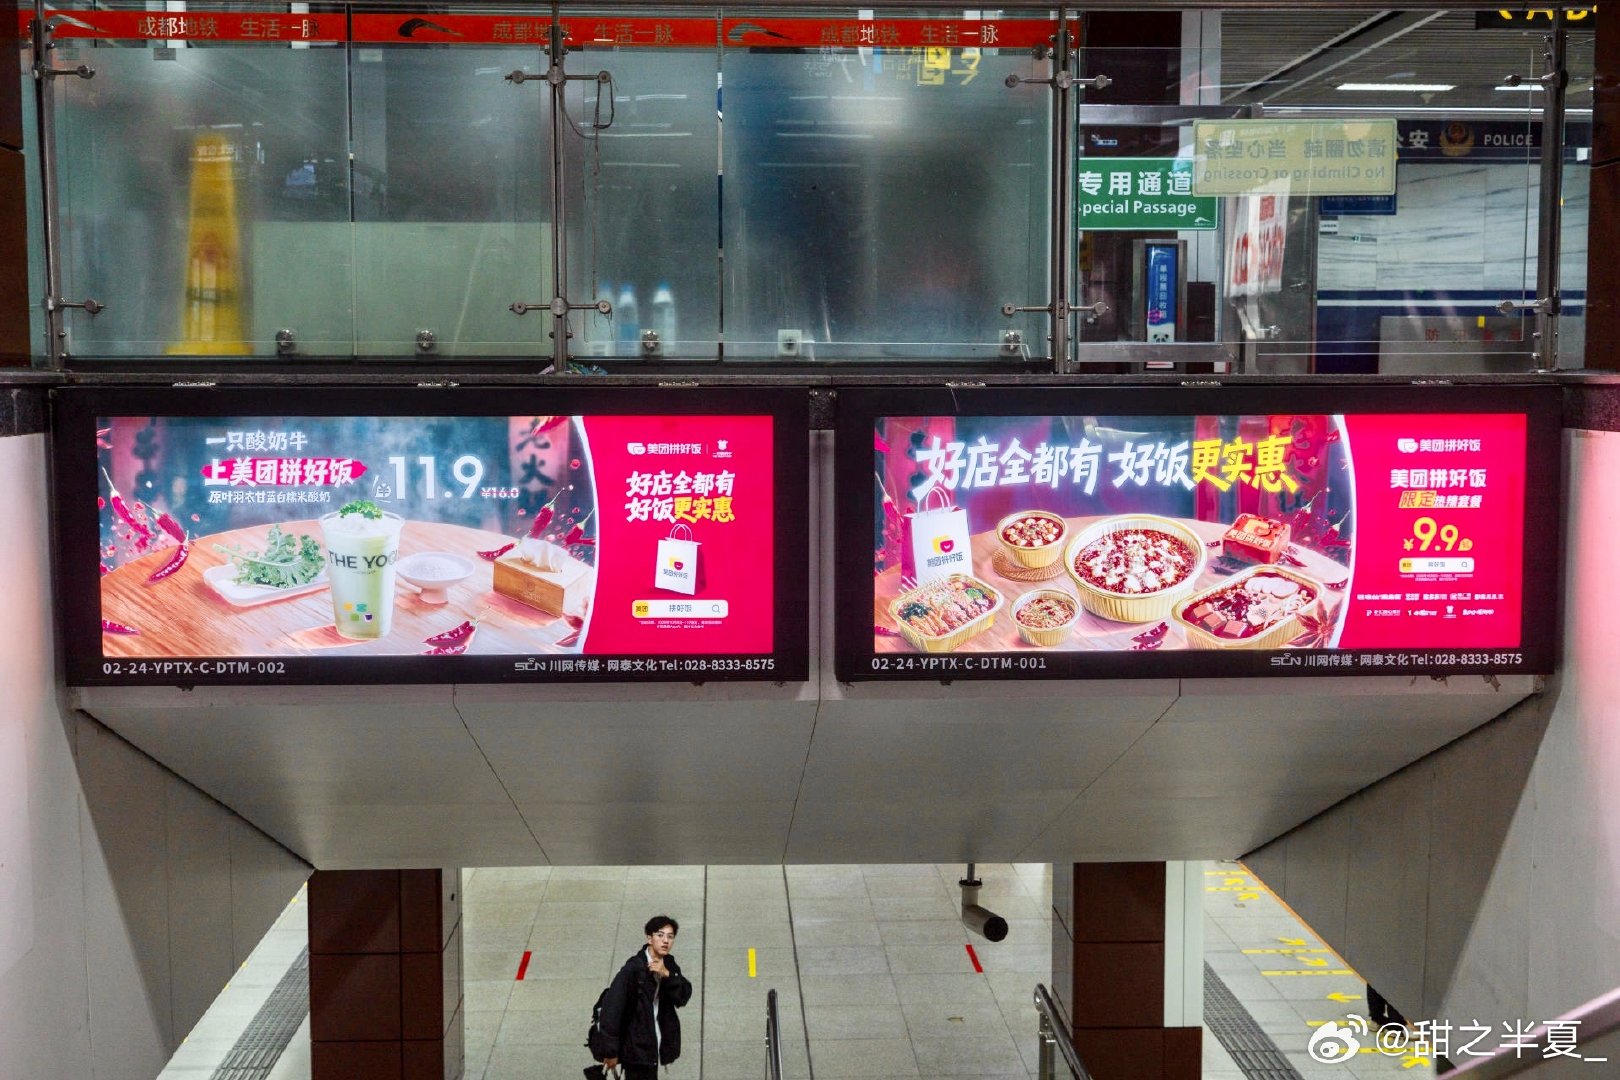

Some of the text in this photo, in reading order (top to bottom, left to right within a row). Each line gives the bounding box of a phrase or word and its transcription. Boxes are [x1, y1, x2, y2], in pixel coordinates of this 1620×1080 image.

[138, 16, 320, 38] 成都地铁 生活一脉
[594, 23, 674, 43] 生活一脉
[820, 24, 999, 44] 成都地铁 生活一脉
[1484, 134, 1534, 146] POLICE
[1079, 171, 1193, 196] 专用通道
[1079, 200, 1197, 217] pecial Passage
[205, 430, 308, 452] 一只酸奶牛
[647, 443, 702, 455] 美团拼好饭
[1420, 438, 1481, 452] 美团拼好饭
[204, 456, 355, 488] 上美团拼好饭
[912, 434, 1299, 500] 好店全都有 好饭更实惠
[625, 470, 736, 497] 好店全都有
[1390, 468, 1487, 489] 美团拼好饭
[624, 496, 736, 524] 好饭更实惠
[328, 550, 358, 569] THE
[102, 661, 285, 674] 02-24-YPTX-C-DTM-002
[871, 657, 1047, 670] 02-24-YPTX-C-DTM-001
